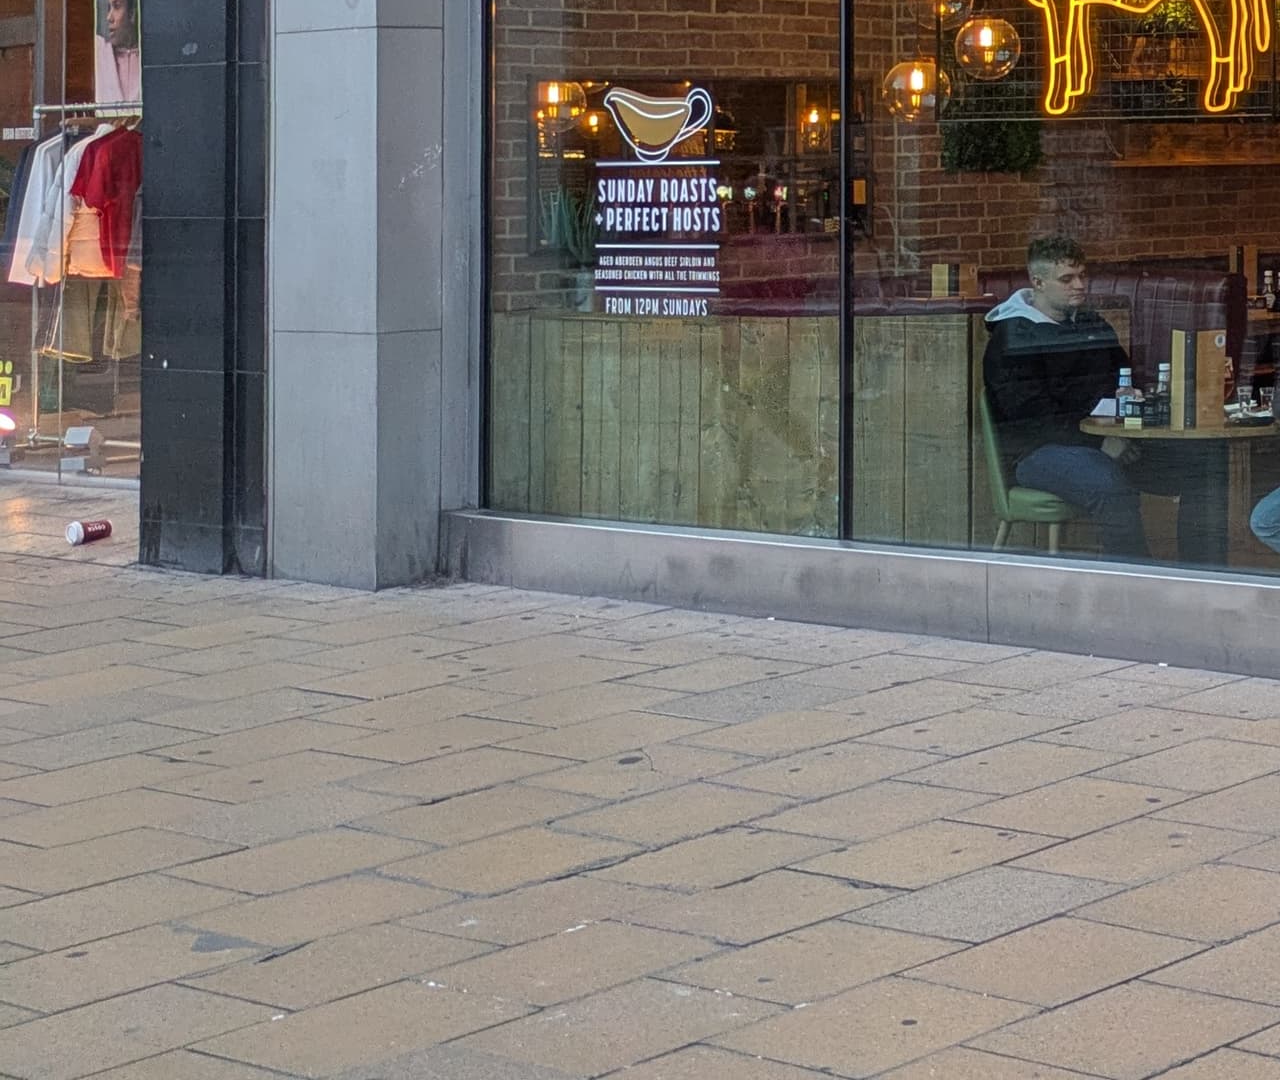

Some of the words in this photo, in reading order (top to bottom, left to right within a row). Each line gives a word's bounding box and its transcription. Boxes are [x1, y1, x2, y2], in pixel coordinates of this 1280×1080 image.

[598, 178, 654, 203] SUNDAY
[660, 178, 717, 202] ROASTS
[673, 207, 720, 232] HOSTS
[644, 256, 663, 267] ANGUS
[664, 256, 678, 267] BEEF
[703, 257, 715, 267] AND
[665, 270, 675, 281] ALL
[677, 270, 687, 281] THE
[606, 297, 631, 314] FROM
[635, 298, 659, 315] 12PM
[663, 298, 708, 317] SUNDAYS
